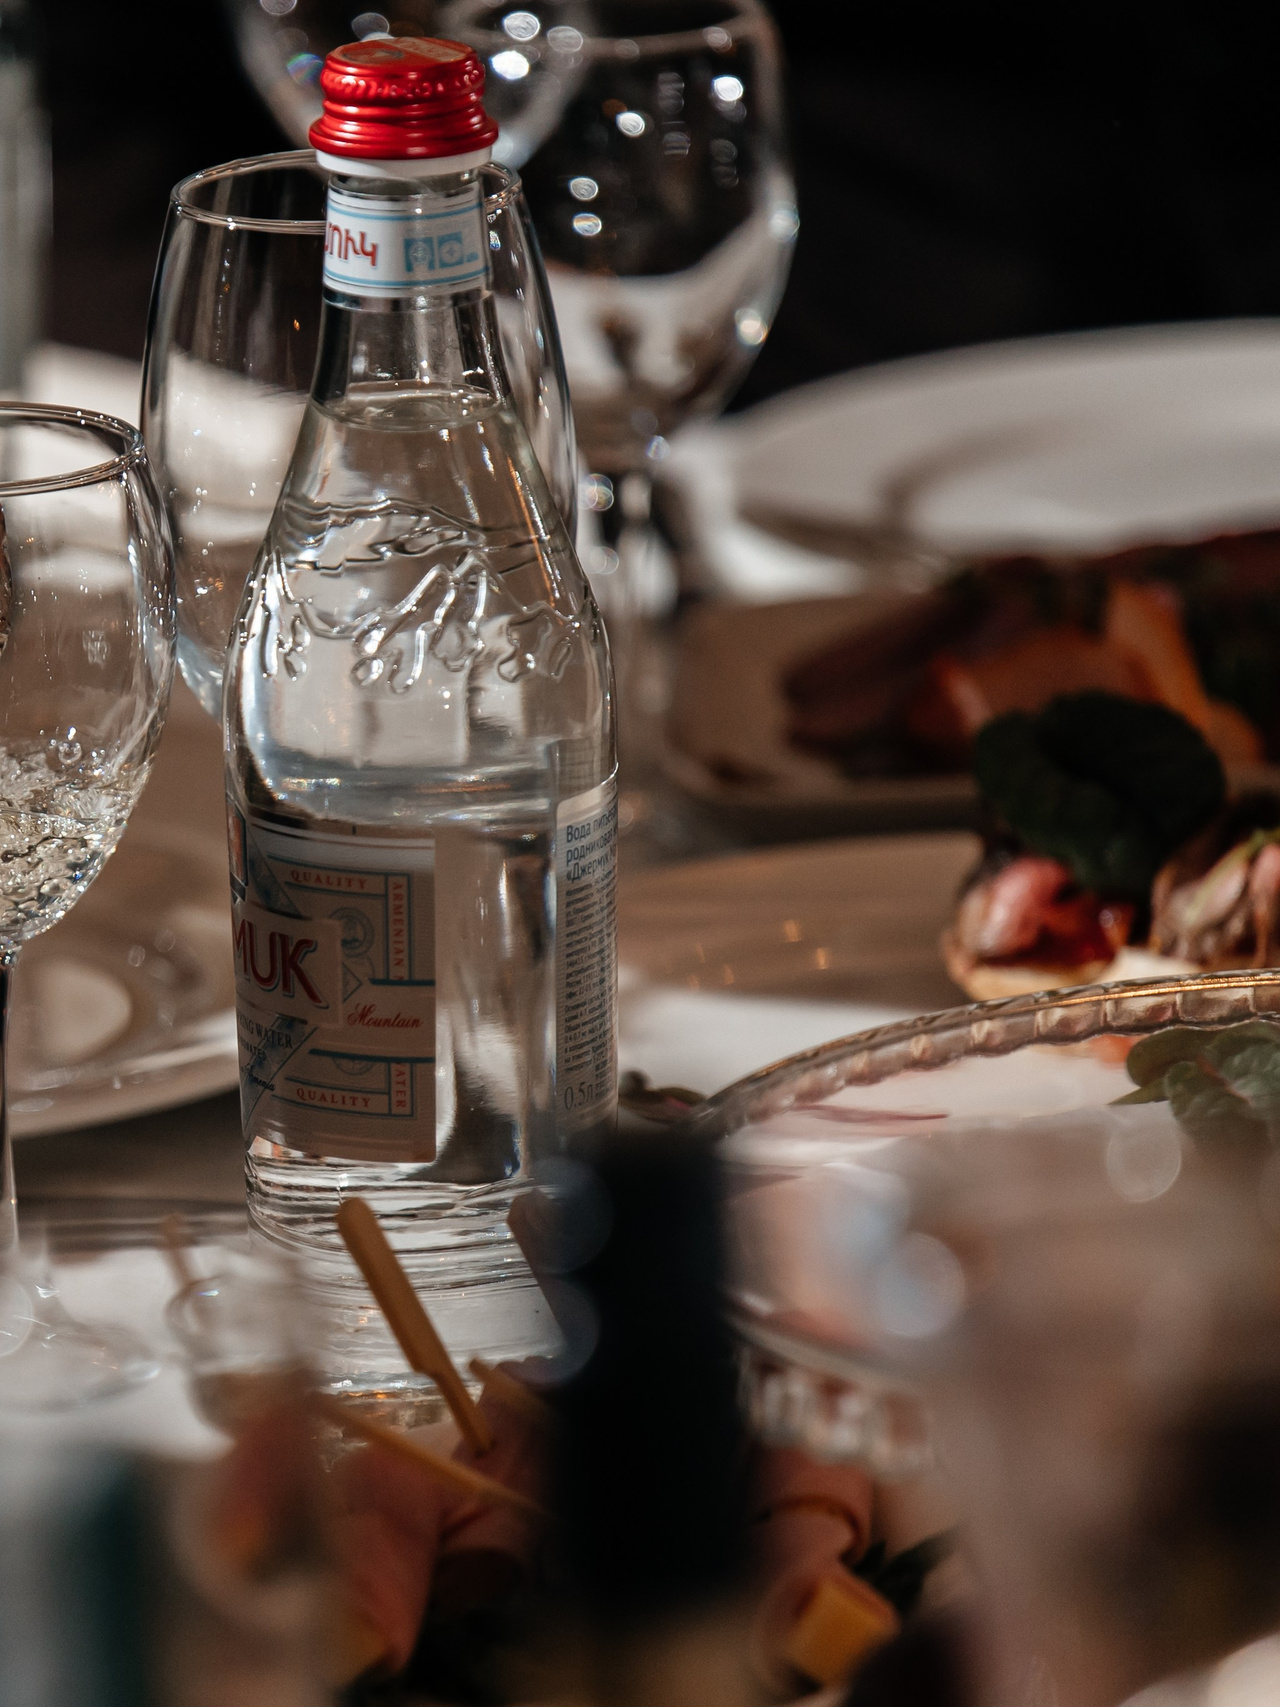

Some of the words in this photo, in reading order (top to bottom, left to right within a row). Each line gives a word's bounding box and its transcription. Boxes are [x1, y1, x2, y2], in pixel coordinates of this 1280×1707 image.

[565, 822, 591, 843] Вода
[291, 869, 368, 889] QUALITY
[392, 882, 405, 967] ARMENIAN
[347, 1004, 426, 1030] Mountain
[255, 1023, 293, 1049] WATER
[296, 1087, 372, 1108] QUALITY
